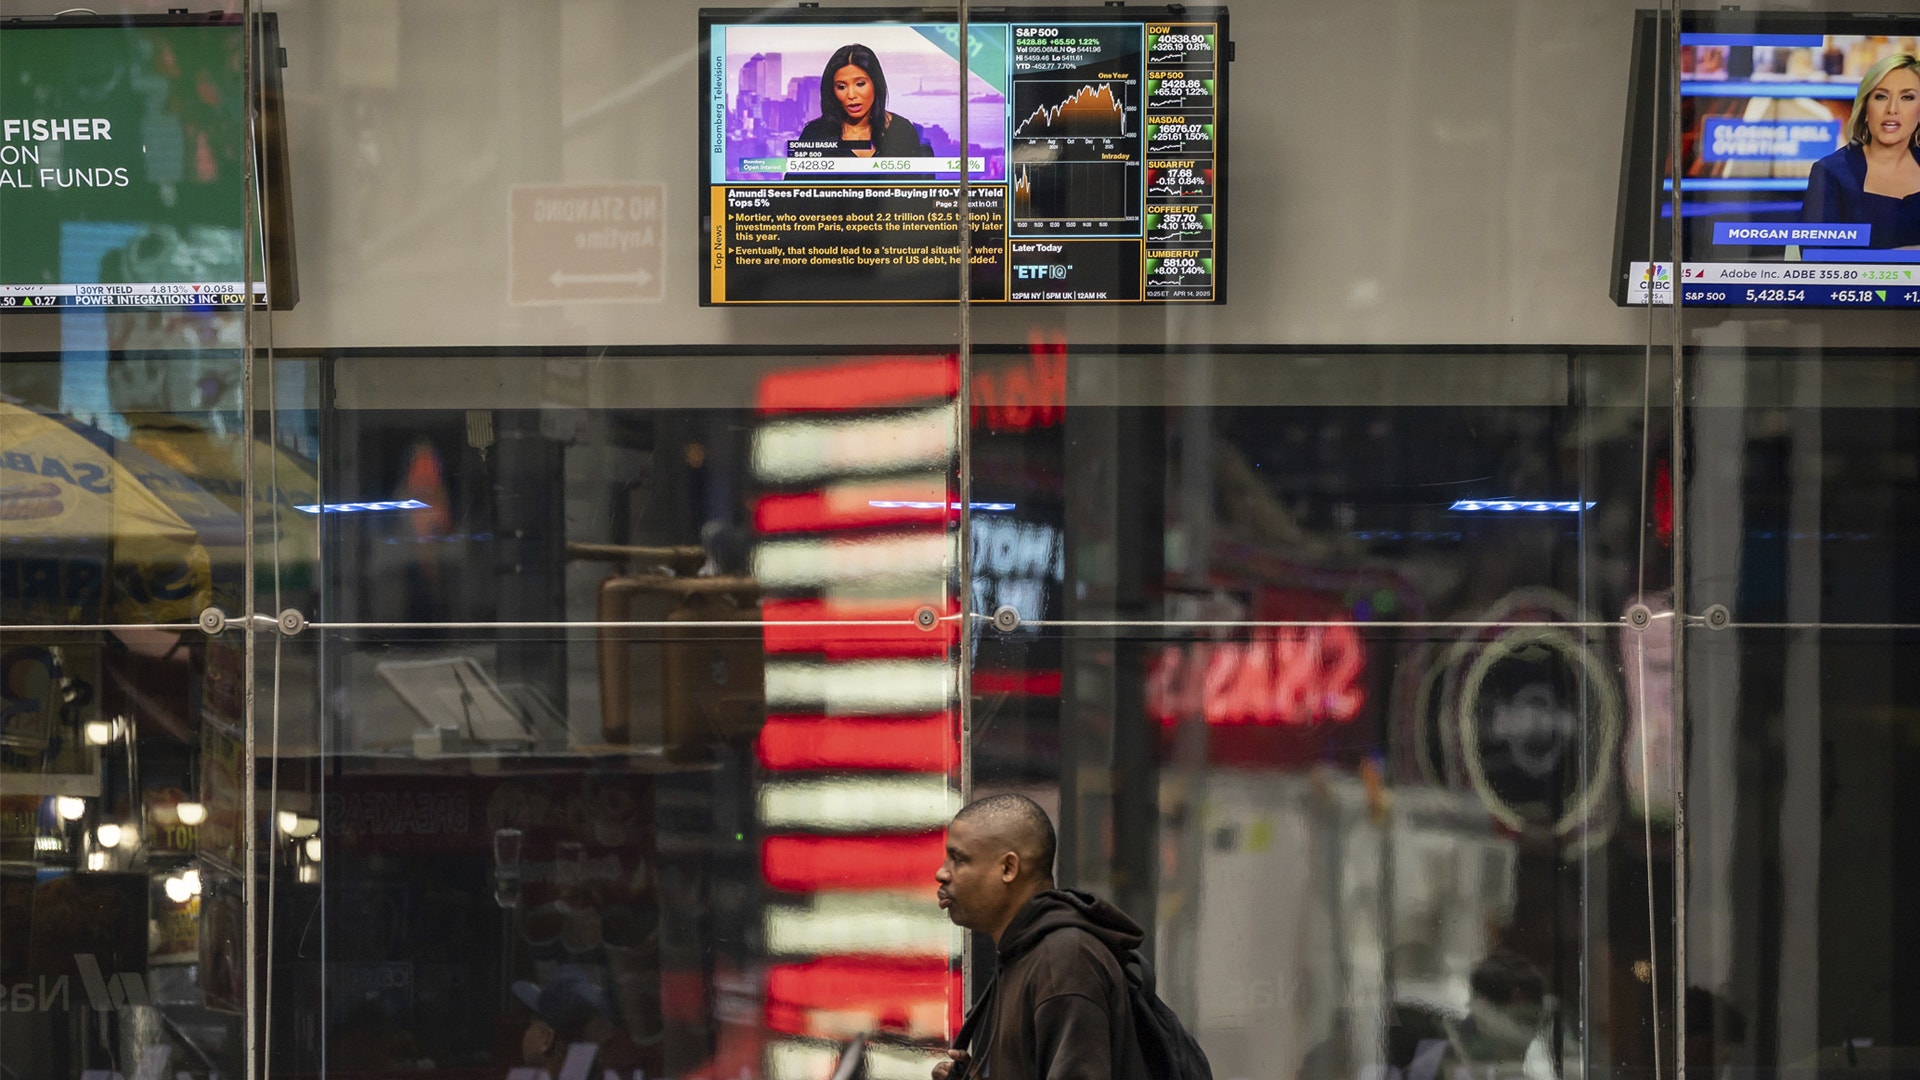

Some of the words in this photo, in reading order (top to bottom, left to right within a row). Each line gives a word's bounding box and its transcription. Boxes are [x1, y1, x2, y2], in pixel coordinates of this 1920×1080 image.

[1016, 28, 1037, 37] S&P
[1038, 28, 1058, 37] 500
[1158, 35, 1204, 43] 40538.90
[714, 56, 722, 102] Television
[1162, 80, 1200, 88] 5428.86
[4, 118, 112, 141] FISHER
[714, 104, 724, 154] Bloomberg
[0, 146, 40, 165] ON
[790, 161, 834, 171] 5,428.92
[881, 161, 910, 169] 65.56
[947, 161, 980, 169] 1.2%
[40, 167, 129, 188] FUNDS
[1168, 169, 1192, 177] 17.68
[728, 189, 766, 197] Amundi
[768, 189, 792, 197] Sees
[794, 189, 812, 197] Fed
[813, 189, 864, 199] Launching
[866, 189, 928, 198] Bond-Buying
[938, 189, 977, 197] 10-Yar
[979, 189, 1003, 197] Yield
[728, 199, 753, 208] Tops
[736, 213, 774, 222] Mortier,
[928, 213, 952, 222] ($2.5
[956, 213, 989, 222] tlion)
[818, 223, 844, 232] Paris,
[846, 223, 882, 232] expects
[903, 223, 958, 231] intervention
[714, 225, 722, 251] News
[756, 234, 780, 242] year.
[1728, 228, 1788, 239] MORGAN
[1792, 230, 1857, 240] BRENNAN
[736, 246, 785, 256] Eventually,
[788, 246, 805, 255] that
[808, 246, 838, 255] should
[840, 246, 860, 255] lead
[882, 246, 928, 255] 'structural
[931, 246, 972, 254] situatin'
[975, 246, 1003, 255] where
[1036, 244, 1062, 253] Today
[714, 254, 724, 270] Top
[736, 256, 761, 264] there
[810, 256, 854, 264] domestic
[858, 256, 890, 266] buyers
[922, 256, 947, 265] debt,
[1720, 269, 1757, 279] Adobe
[1761, 270, 1780, 279] Inc.
[1783, 270, 1815, 279] ADBE
[1820, 270, 1858, 279] 355.80
[1862, 271, 1898, 279] +3.325
[150, 285, 188, 293] 4.813%
[204, 285, 234, 293] 0.058
[35, 296, 56, 306] 0.27
[76, 296, 114, 305] POWER
[117, 295, 195, 305] INTEGRATIONS
[198, 295, 217, 304] INC
[221, 294, 256, 304] (POW)
[1746, 290, 1805, 302] 5,428.54
[1830, 290, 1872, 301] +65.18
